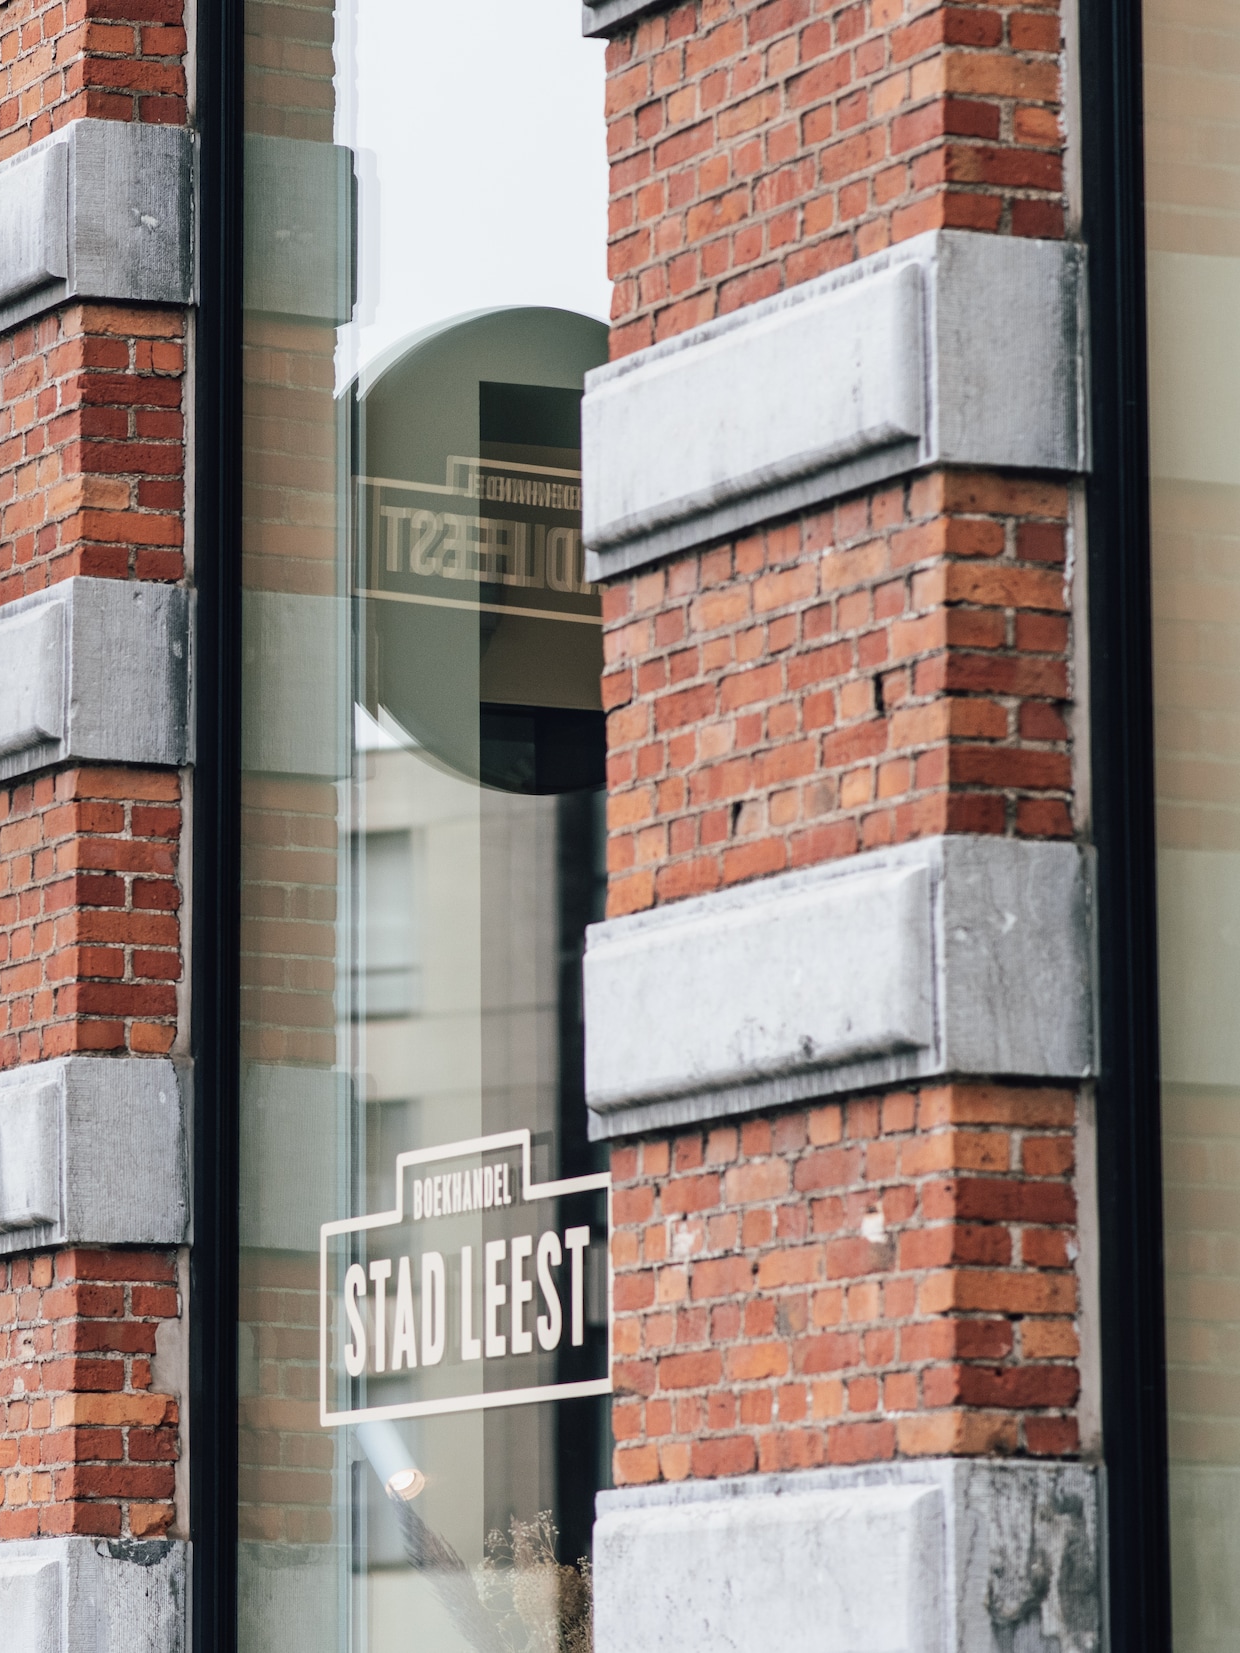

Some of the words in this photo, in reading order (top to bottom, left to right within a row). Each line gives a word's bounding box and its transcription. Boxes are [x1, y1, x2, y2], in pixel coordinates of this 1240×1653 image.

[413, 1163, 512, 1221] BOEKHANDEL
[344, 1251, 446, 1377] STAD
[461, 1225, 591, 1361] LEEST
